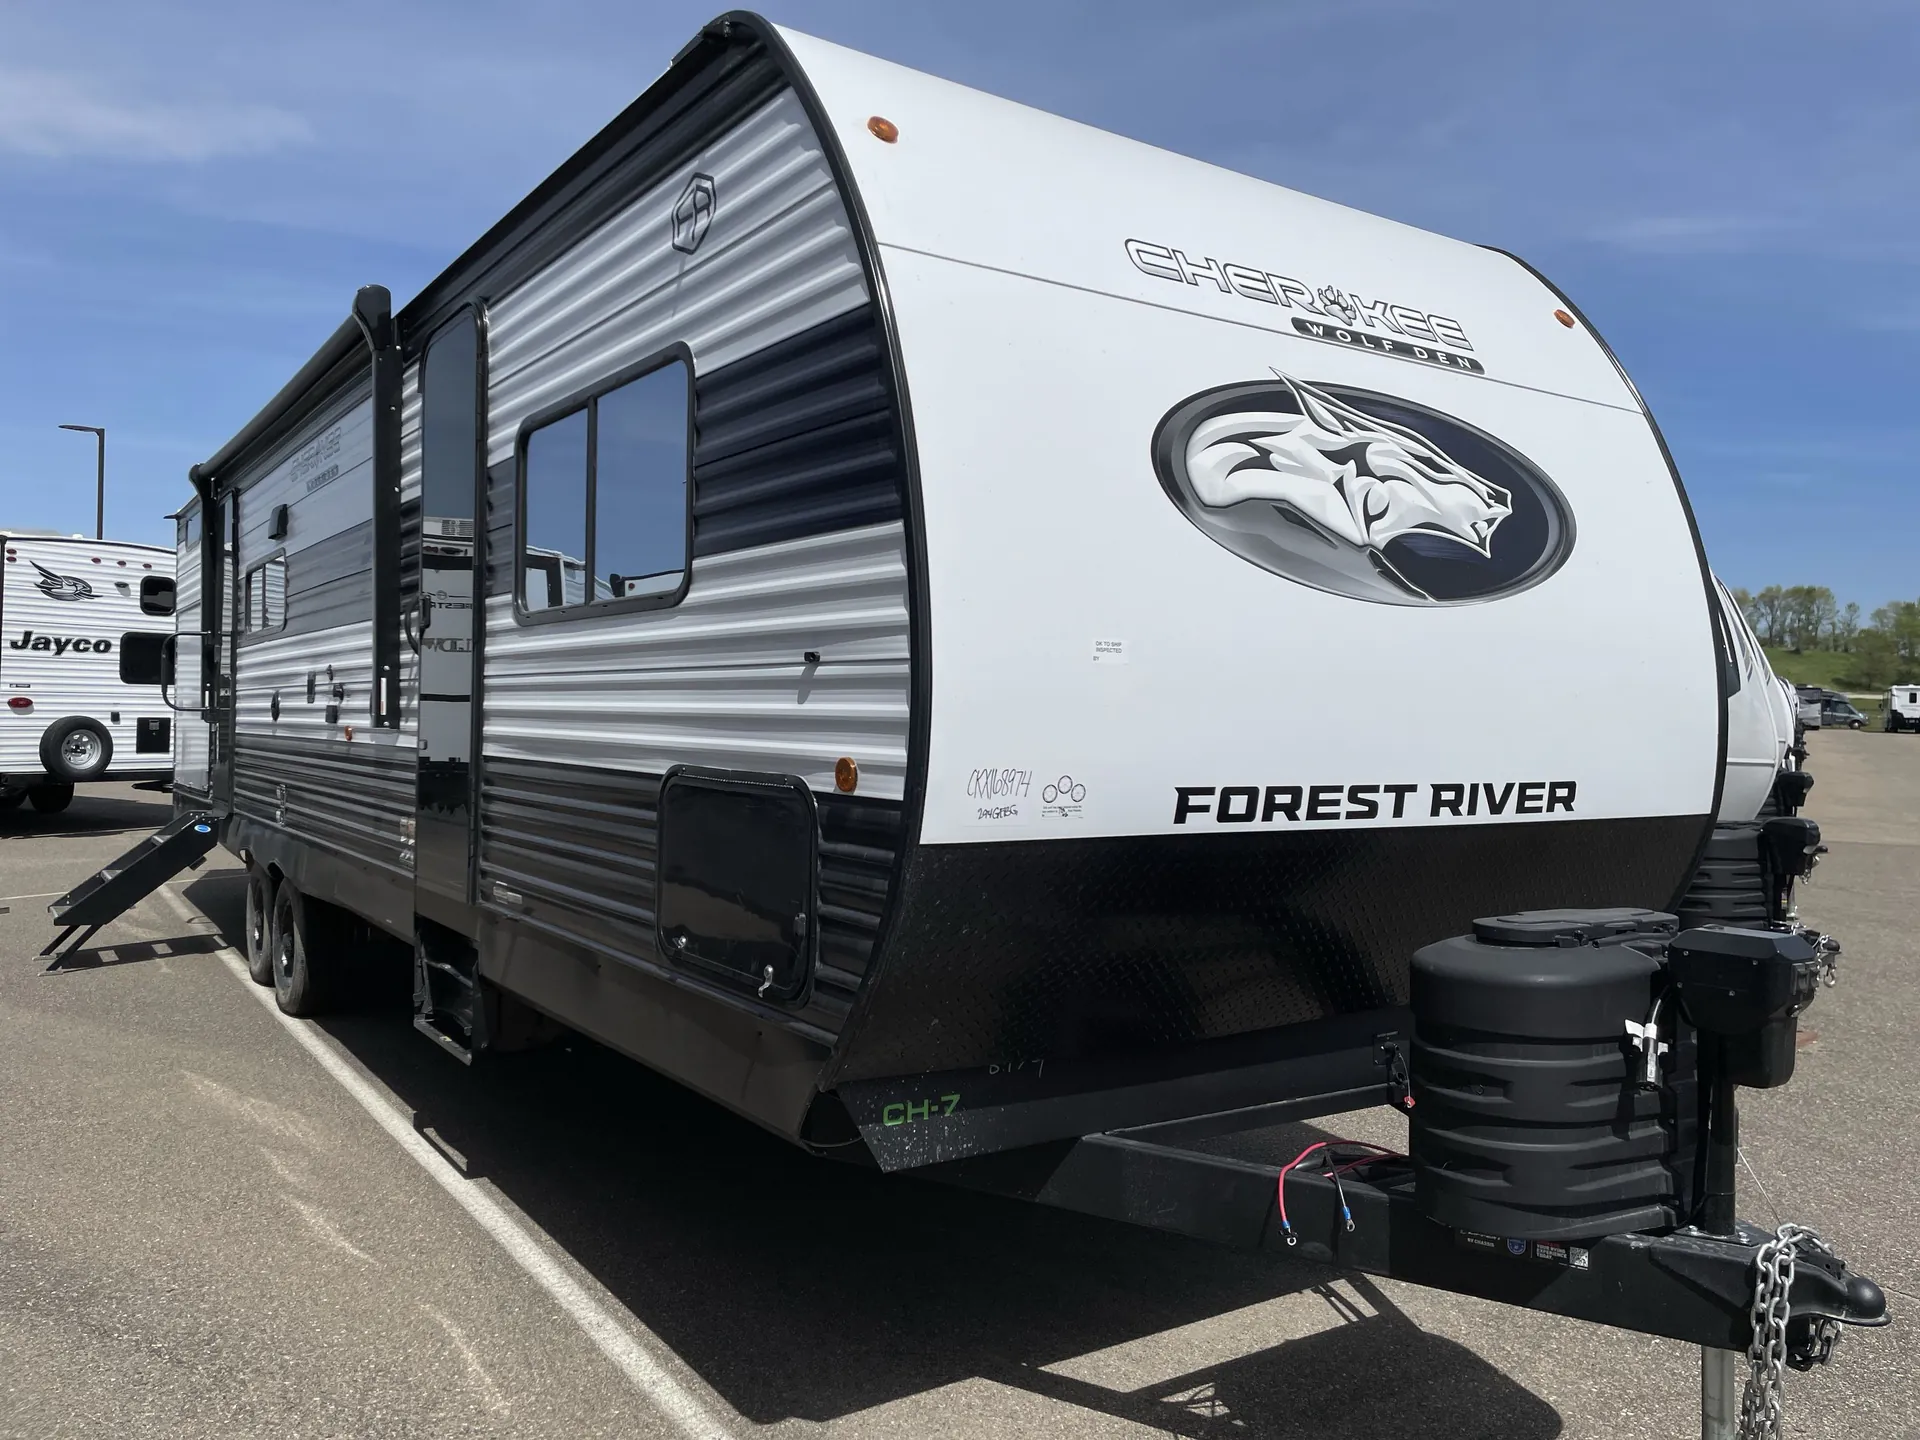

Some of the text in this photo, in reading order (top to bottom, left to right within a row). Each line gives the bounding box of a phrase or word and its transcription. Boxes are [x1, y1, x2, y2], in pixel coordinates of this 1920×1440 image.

[1305, 322, 1472, 370] WOLF DEN
[9, 630, 112, 656] Jayco
[1173, 781, 1577, 825] FOREST RIVER
[883, 1094, 961, 1126] CH-7
